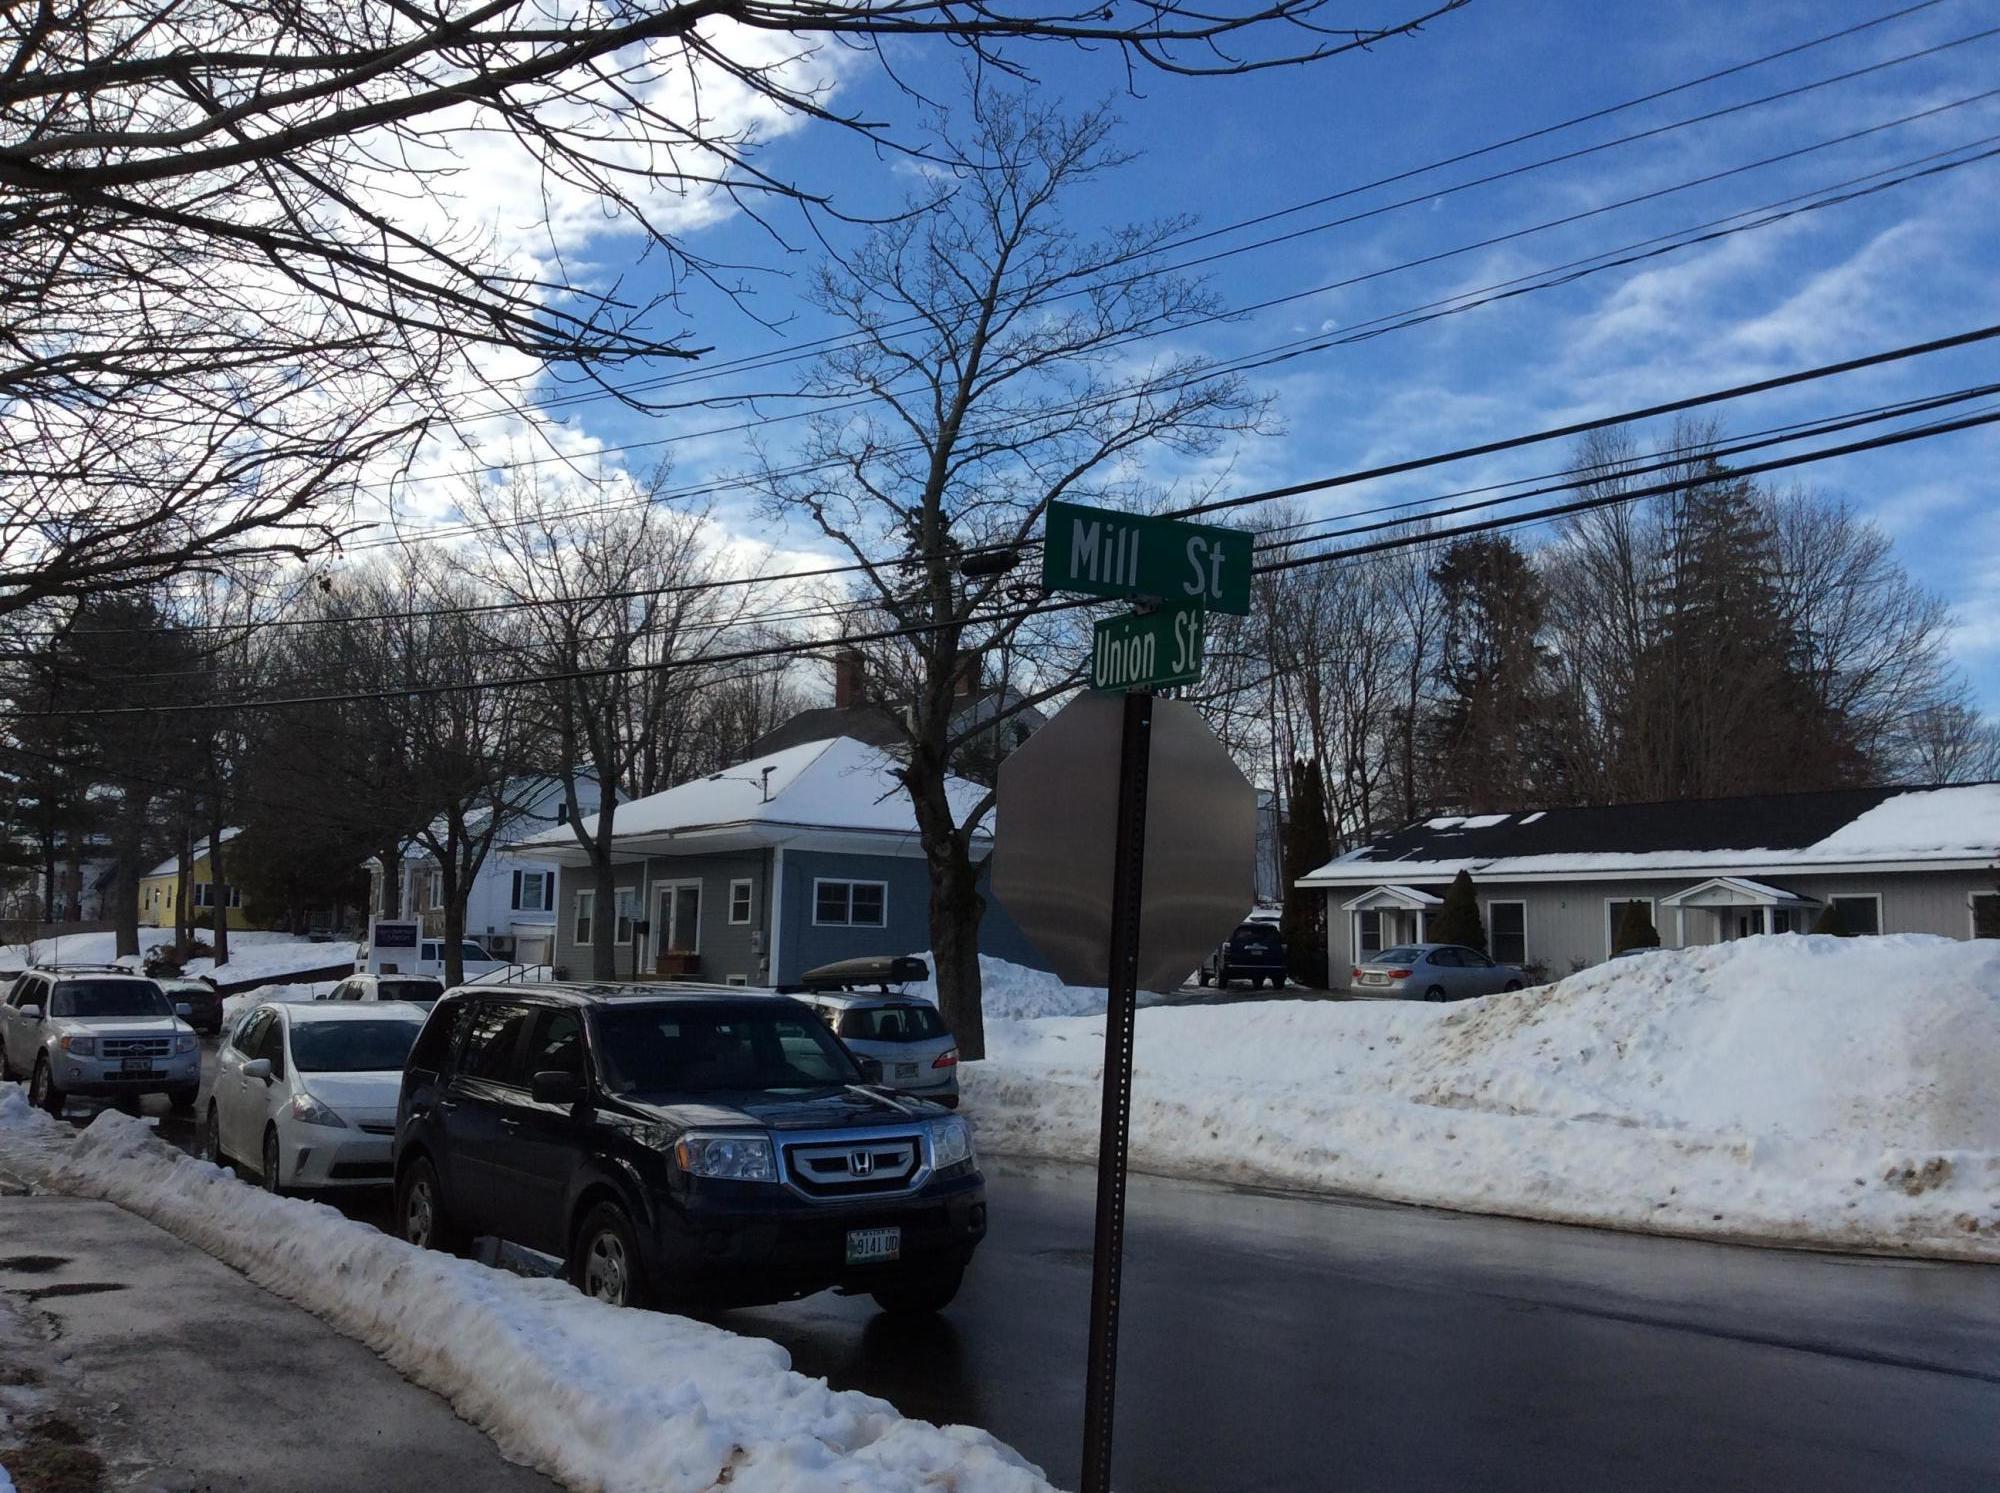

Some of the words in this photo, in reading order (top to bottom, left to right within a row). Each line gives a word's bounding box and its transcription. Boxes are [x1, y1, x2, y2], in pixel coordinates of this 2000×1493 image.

[1070, 518, 1140, 587] Mill
[1183, 536, 1226, 599] St
[1095, 624, 1155, 688] Union
[1171, 608, 1198, 675] St
[856, 1236, 881, 1255] 9141
